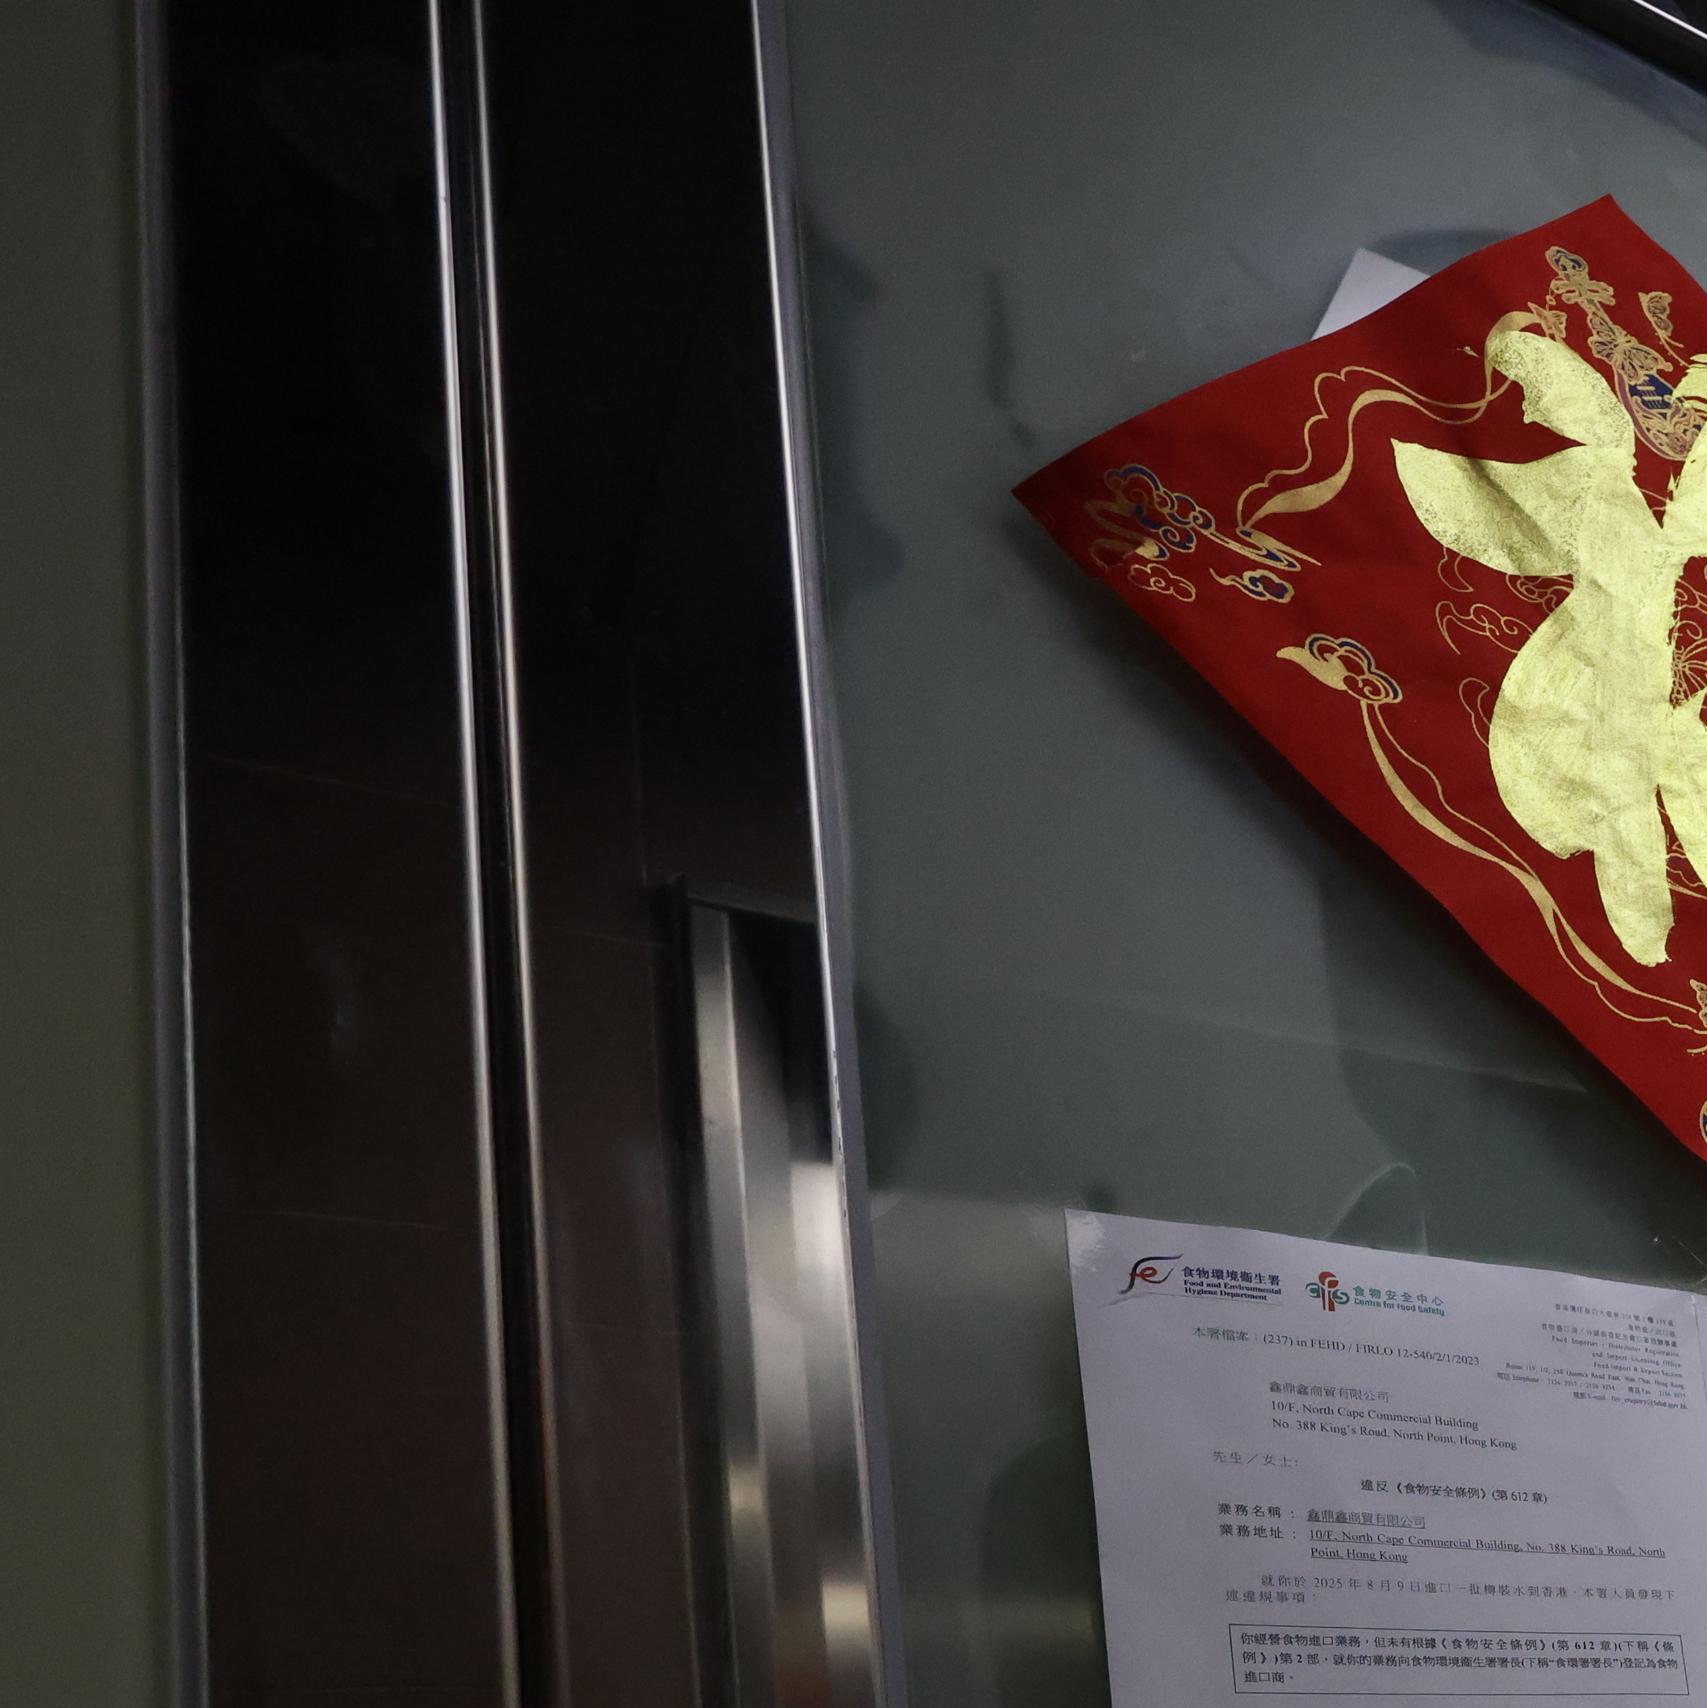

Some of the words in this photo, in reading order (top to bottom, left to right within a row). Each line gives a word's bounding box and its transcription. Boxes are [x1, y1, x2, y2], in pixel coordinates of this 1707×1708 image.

[1351, 1284, 1444, 1307] 食物安全中心
[1270, 1399, 1300, 1414] 10/F,
[1301, 1402, 1335, 1416] North
[1336, 1405, 1365, 1420] Cape
[1366, 1408, 1432, 1425] Commercial
[1433, 1414, 1479, 1432] Building
